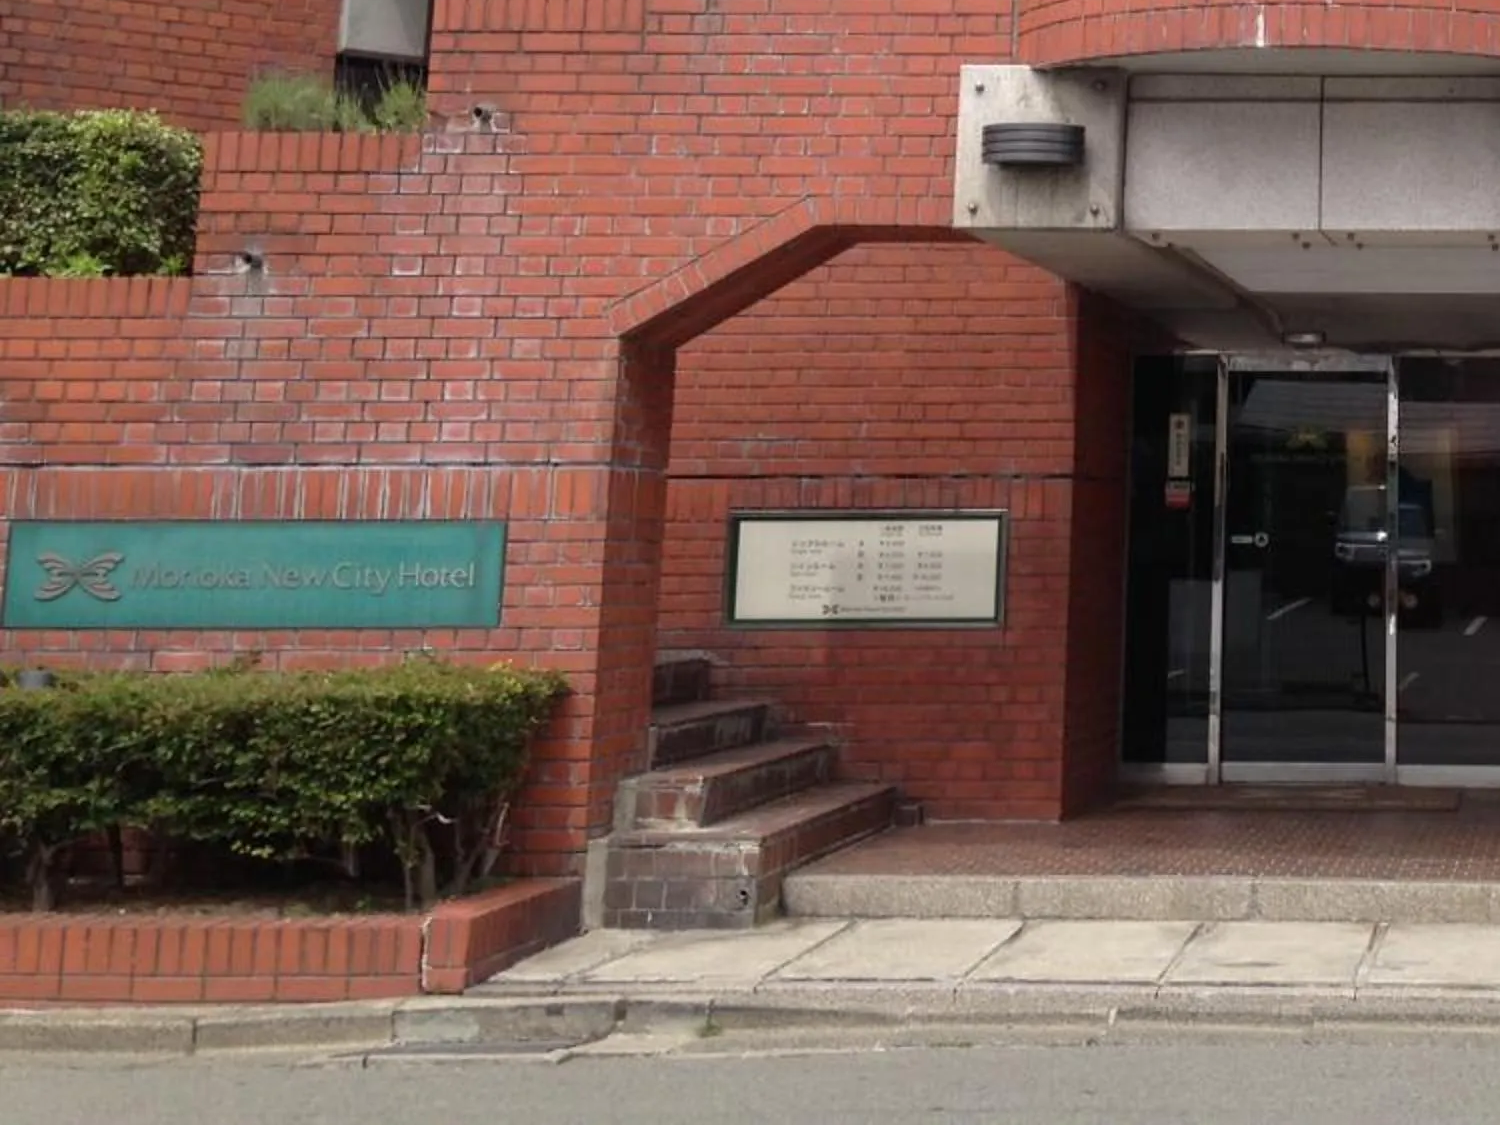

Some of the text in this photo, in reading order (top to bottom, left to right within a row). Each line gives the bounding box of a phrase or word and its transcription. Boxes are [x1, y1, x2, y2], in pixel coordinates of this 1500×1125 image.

[131, 561, 476, 595] Morioka New City Hotel
